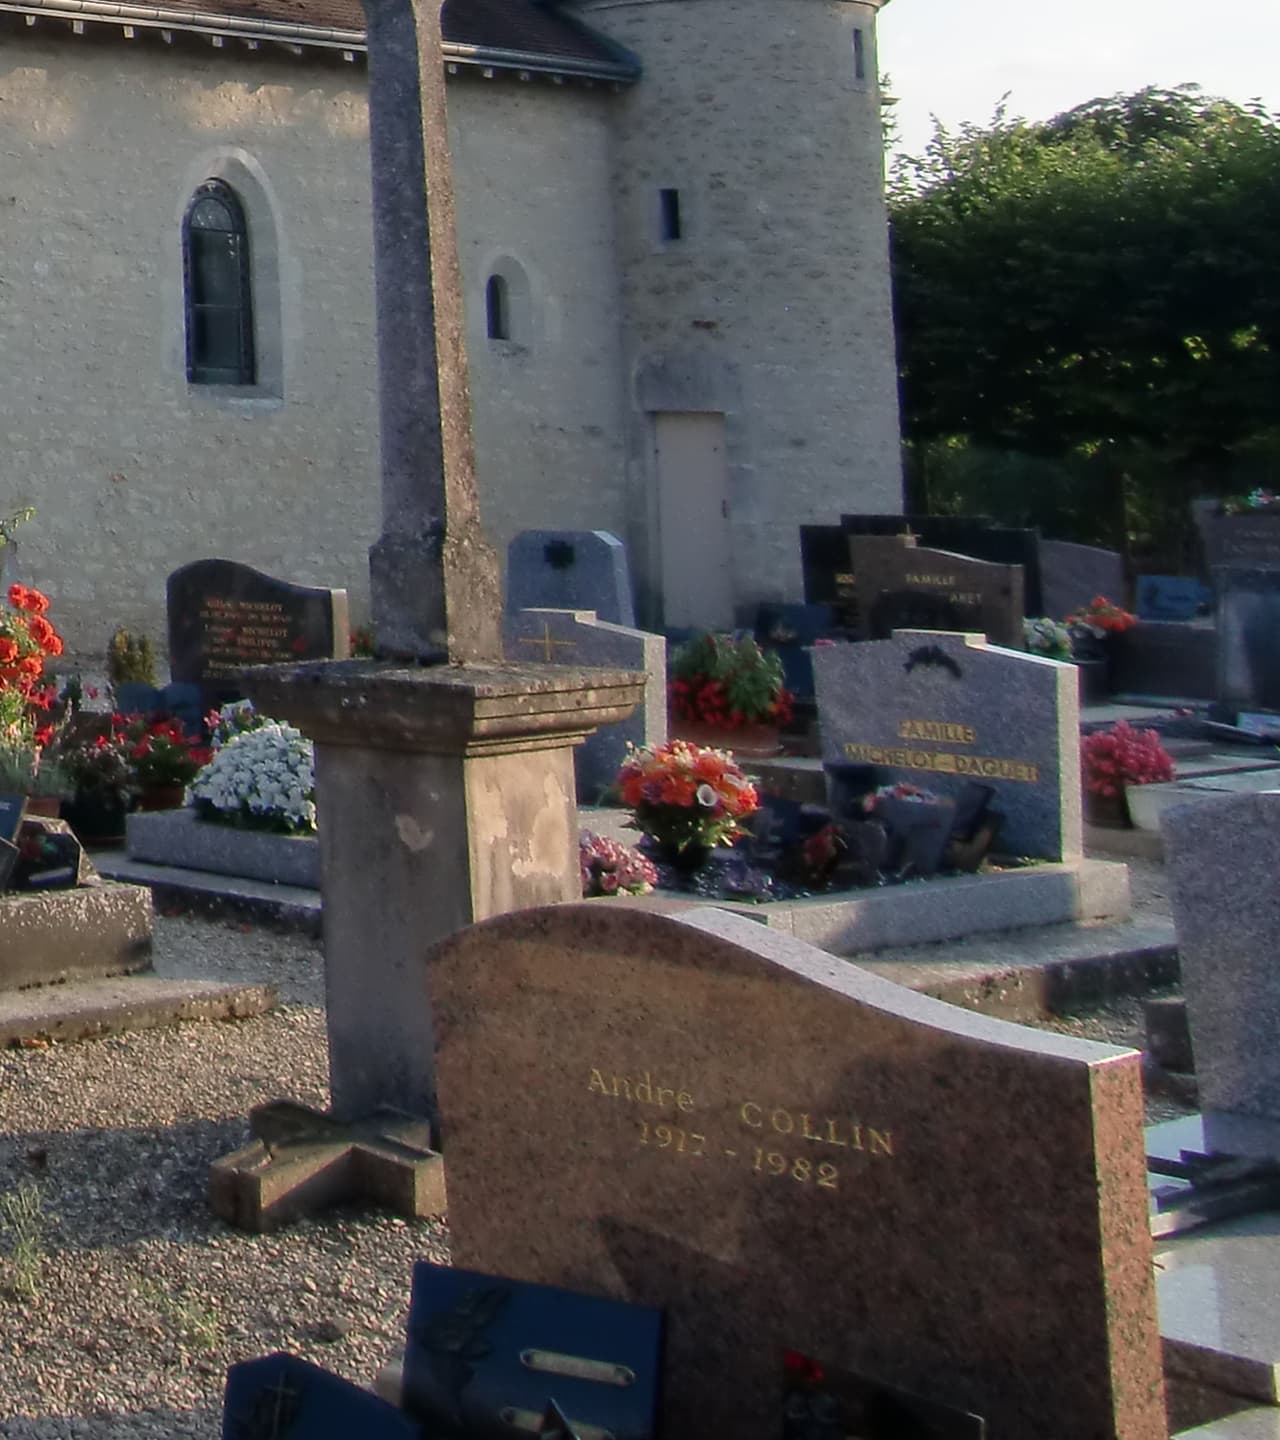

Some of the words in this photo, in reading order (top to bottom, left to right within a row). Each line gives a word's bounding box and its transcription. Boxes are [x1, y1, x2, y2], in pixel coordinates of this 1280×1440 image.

[905, 574, 956, 585] FAMILLE
[898, 719, 976, 744] FAMILLE
[845, 743, 937, 772] MICHELOT
[954, 754, 1039, 782] DAGUET
[741, 1102, 895, 1155] COLLIN
[639, 1119, 705, 1156] 1917
[754, 1147, 838, 1188] 1982
